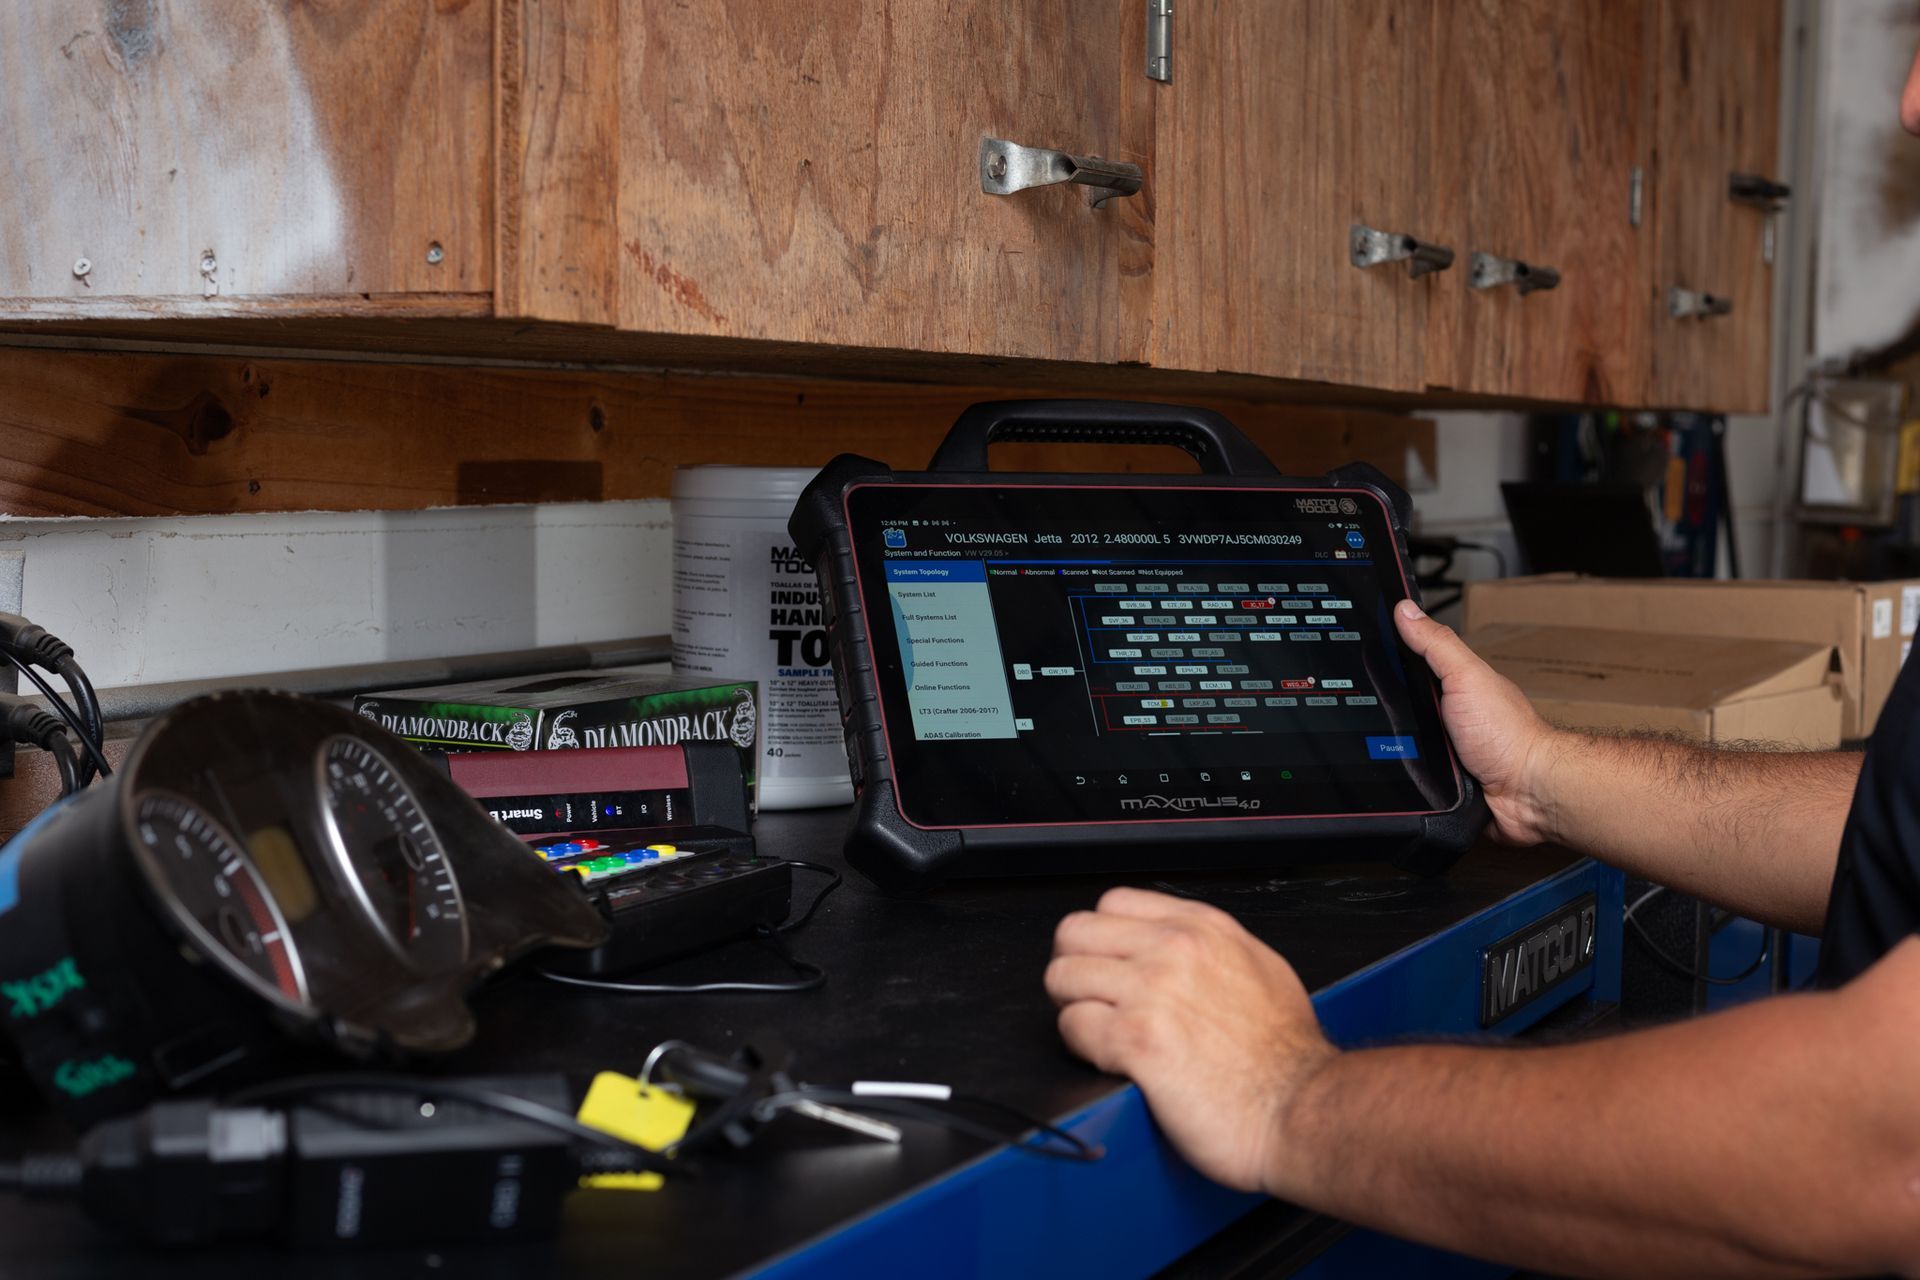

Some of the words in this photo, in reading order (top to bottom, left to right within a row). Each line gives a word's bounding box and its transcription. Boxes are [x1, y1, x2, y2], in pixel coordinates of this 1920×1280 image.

[1297, 506, 1338, 514] TOOLS
[944, 533, 1028, 544] VOLKSWAGEN
[1034, 533, 1062, 544] Jetta
[1070, 534, 1099, 544] 2012
[1103, 534, 1160, 544] 2.480000L
[1163, 534, 1170, 544] 5
[1178, 534, 1302, 545] 3VWDP7AJ5CM030249
[884, 550, 912, 558] System
[919, 568, 949, 577] Topology
[771, 608, 826, 626] HAN
[778, 668, 819, 677] SAMPLE
[933, 708, 958, 716] (Crafter
[381, 711, 504, 742] DIAMONDBACK
[584, 708, 730, 749] DIAMONDBACK
[767, 748, 783, 758] 40
[1380, 744, 1404, 752] Pause
[1120, 795, 1238, 811] MAXIMUS
[1238, 799, 1260, 810] 4.0
[501, 808, 543, 821] Smart
[616, 805, 623, 816] BT
[1490, 915, 1578, 1017] MATCO
